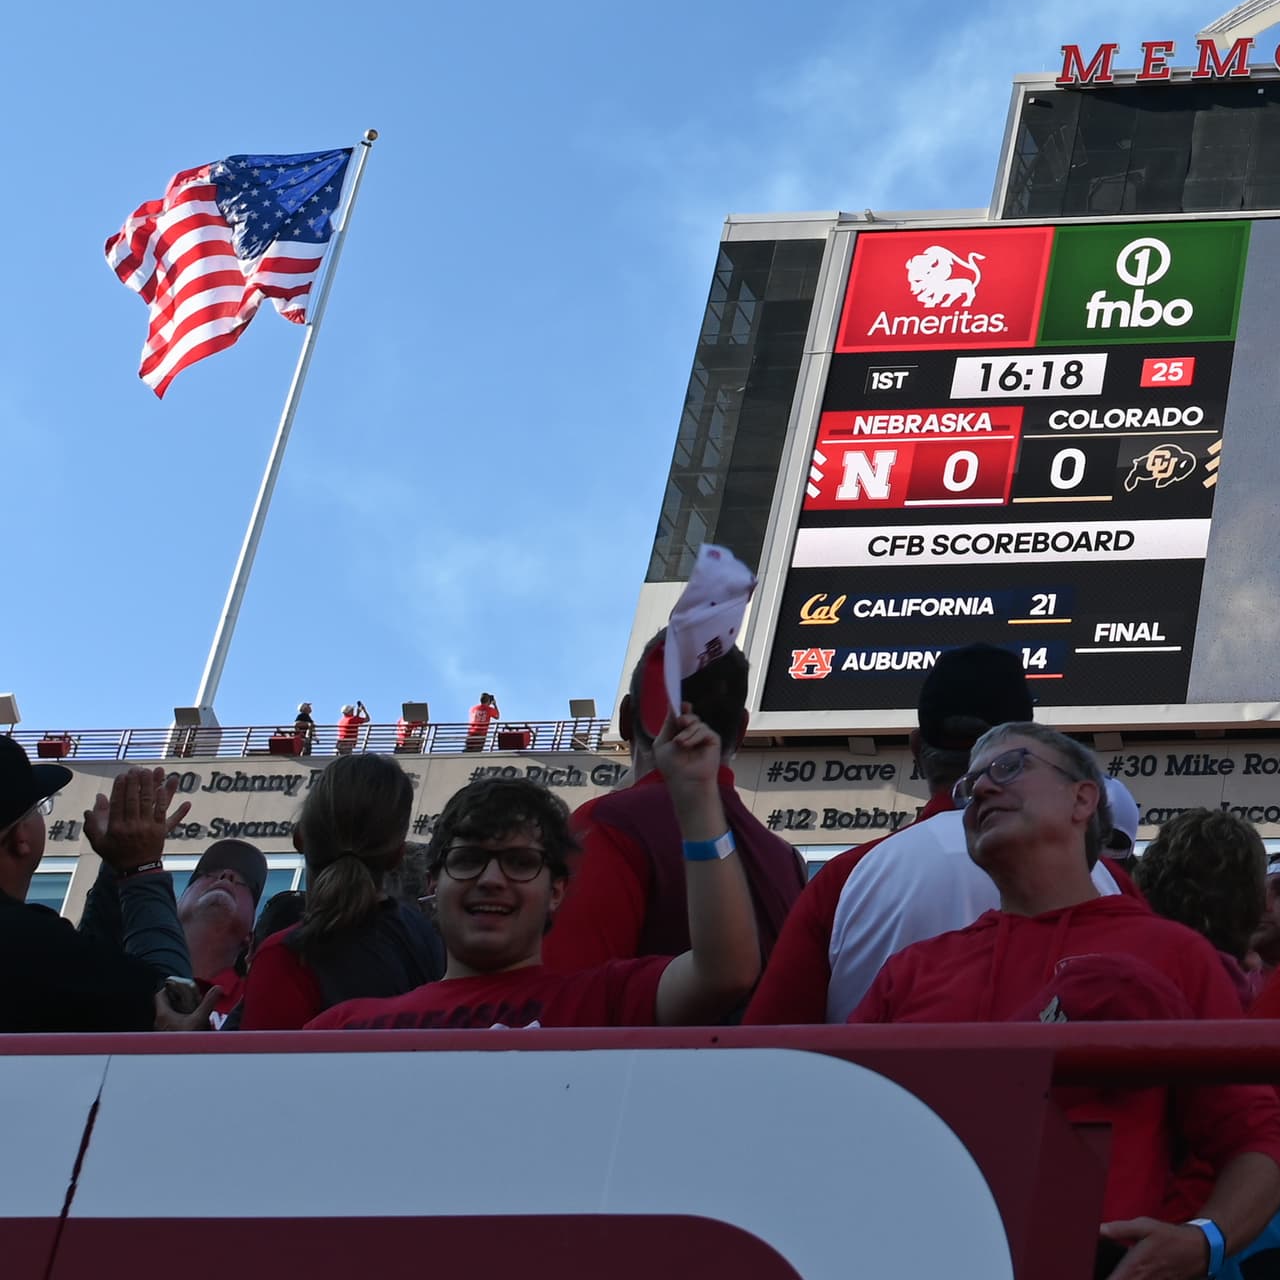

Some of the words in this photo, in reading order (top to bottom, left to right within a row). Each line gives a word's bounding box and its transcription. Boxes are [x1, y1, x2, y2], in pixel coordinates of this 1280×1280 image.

[1086, 290, 1194, 329] fnbo
[871, 371, 910, 390] 1ST
[979, 360, 1084, 392] 16:18
[1151, 362, 1185, 383] 25
[853, 412, 993, 436] NEBRASKA
[1048, 406, 1204, 431] COLORADO
[835, 449, 898, 501] N
[942, 450, 979, 492] 0
[1050, 448, 1087, 490] 0
[867, 534, 926, 557] CFB
[931, 530, 1136, 555] SCOREBOARD
[799, 593, 848, 624] Cal
[853, 597, 995, 618] CALIFORNIA
[1030, 594, 1057, 616] 21
[1094, 622, 1166, 642] FINAL
[841, 651, 942, 671] AUBURN
[1021, 647, 1048, 670] 14
[767, 760, 816, 783] #50
[822, 760, 896, 781] Dave
[1108, 754, 1157, 778] #30
[1164, 754, 1235, 776] Mike
[202, 771, 302, 796] Johnny
[766, 809, 813, 831] #12
[820, 807, 907, 832] Bobby
